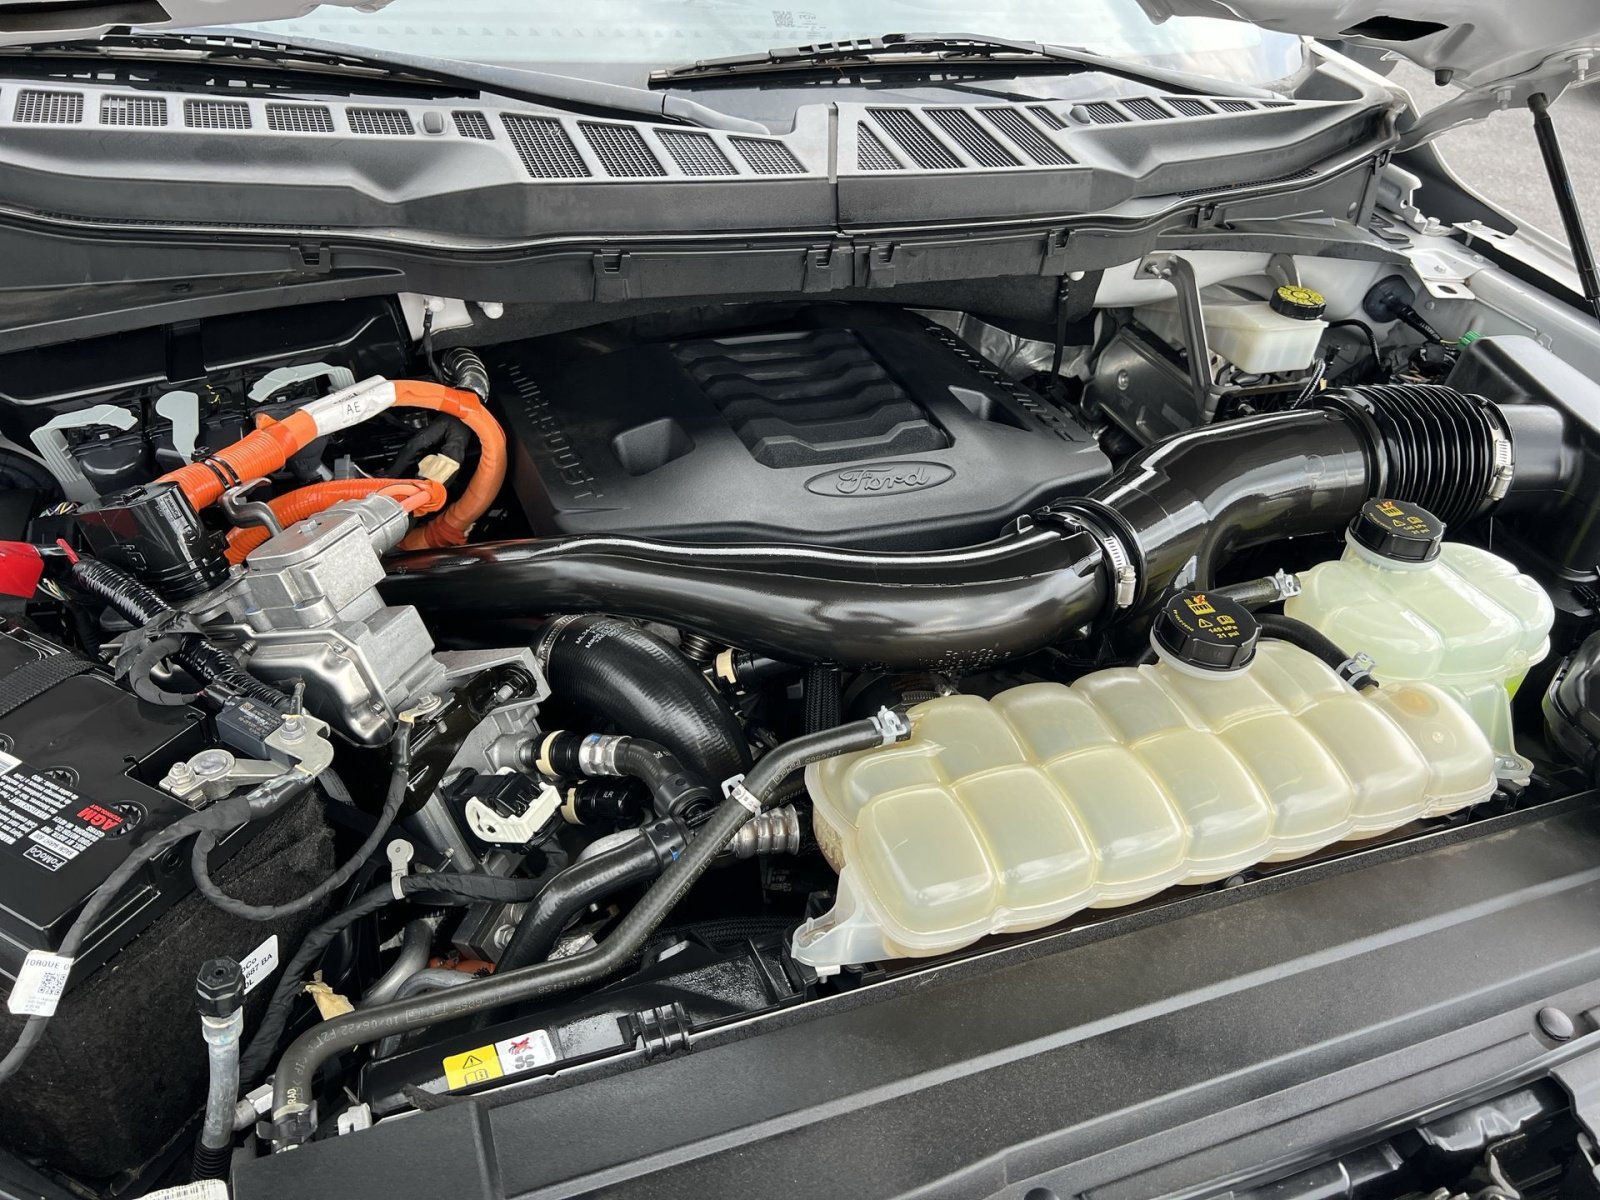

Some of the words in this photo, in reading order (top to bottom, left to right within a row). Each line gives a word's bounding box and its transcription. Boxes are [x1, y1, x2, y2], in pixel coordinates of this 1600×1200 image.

[836, 466, 930, 494] Ford
[1227, 630, 1240, 638] psi
[77, 807, 119, 831] AGM
[30, 848, 63, 868] FoMoCo
[25, 959, 60, 970] TORQUE
[261, 953, 273, 966] BA
[286, 1088, 298, 1105] RAD
